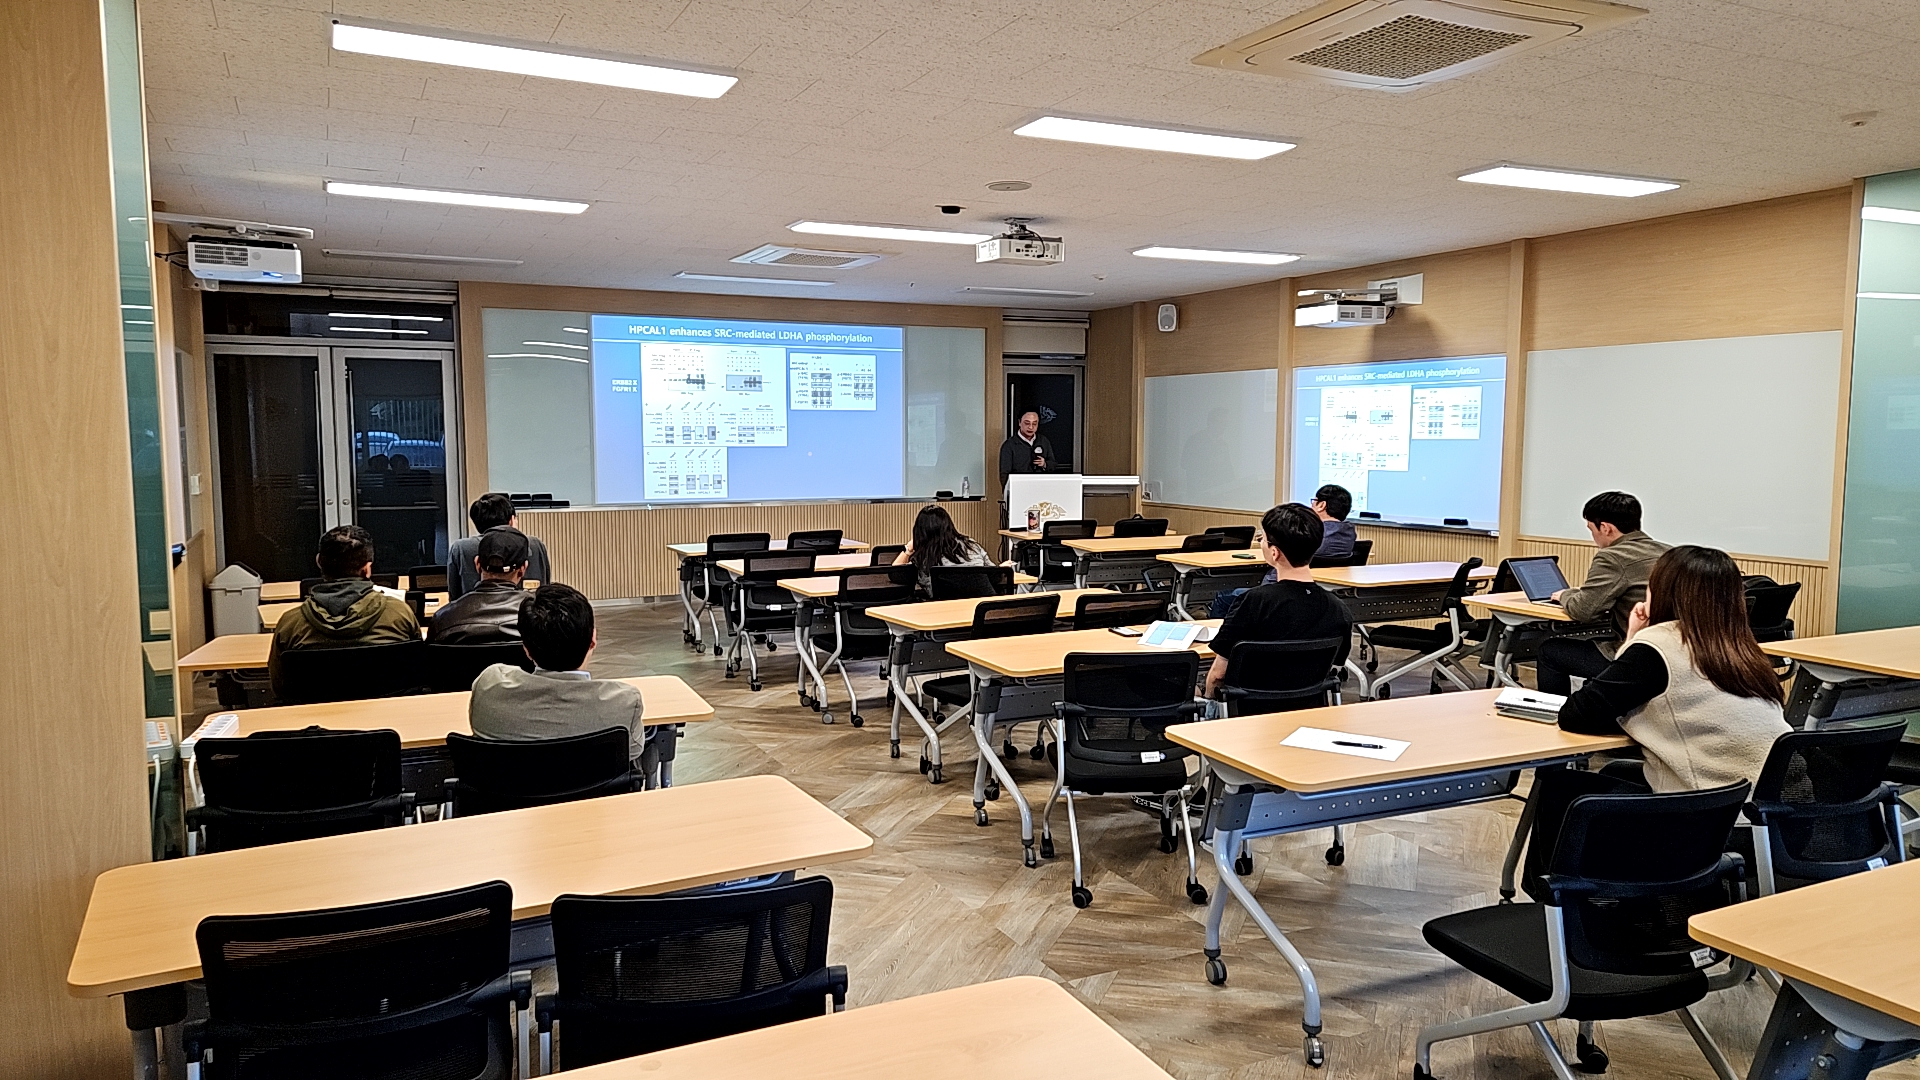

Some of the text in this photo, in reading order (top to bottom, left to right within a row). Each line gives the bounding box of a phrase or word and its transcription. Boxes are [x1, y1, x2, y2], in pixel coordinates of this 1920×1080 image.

[628, 324, 873, 344] HPCAL1 enhances SRC-mediated LDHA phosphorylation
